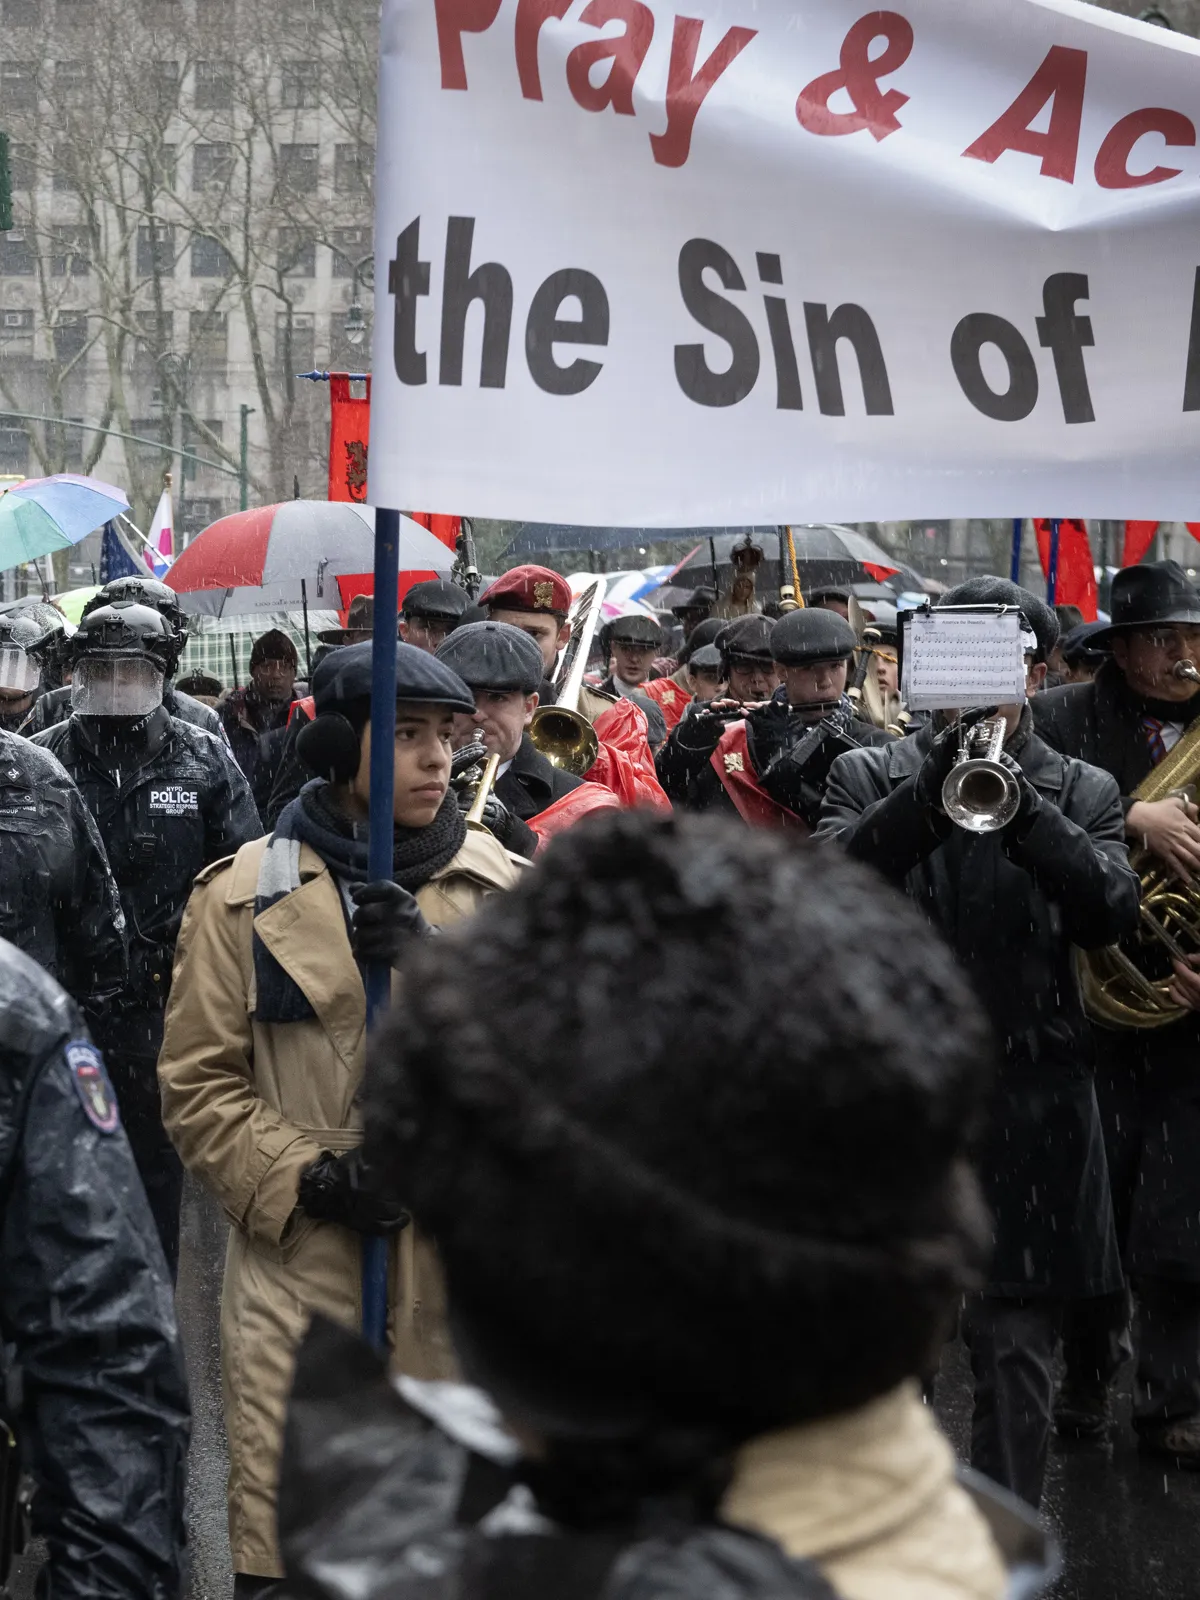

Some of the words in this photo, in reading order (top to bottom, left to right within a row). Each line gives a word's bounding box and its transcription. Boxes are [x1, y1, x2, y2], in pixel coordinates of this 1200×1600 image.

[796, 10, 914, 143] &
[388, 214, 610, 396] the
[674, 237, 895, 417] Sin
[950, 272, 1096, 424] of
[150, 791, 198, 804] POLICE
